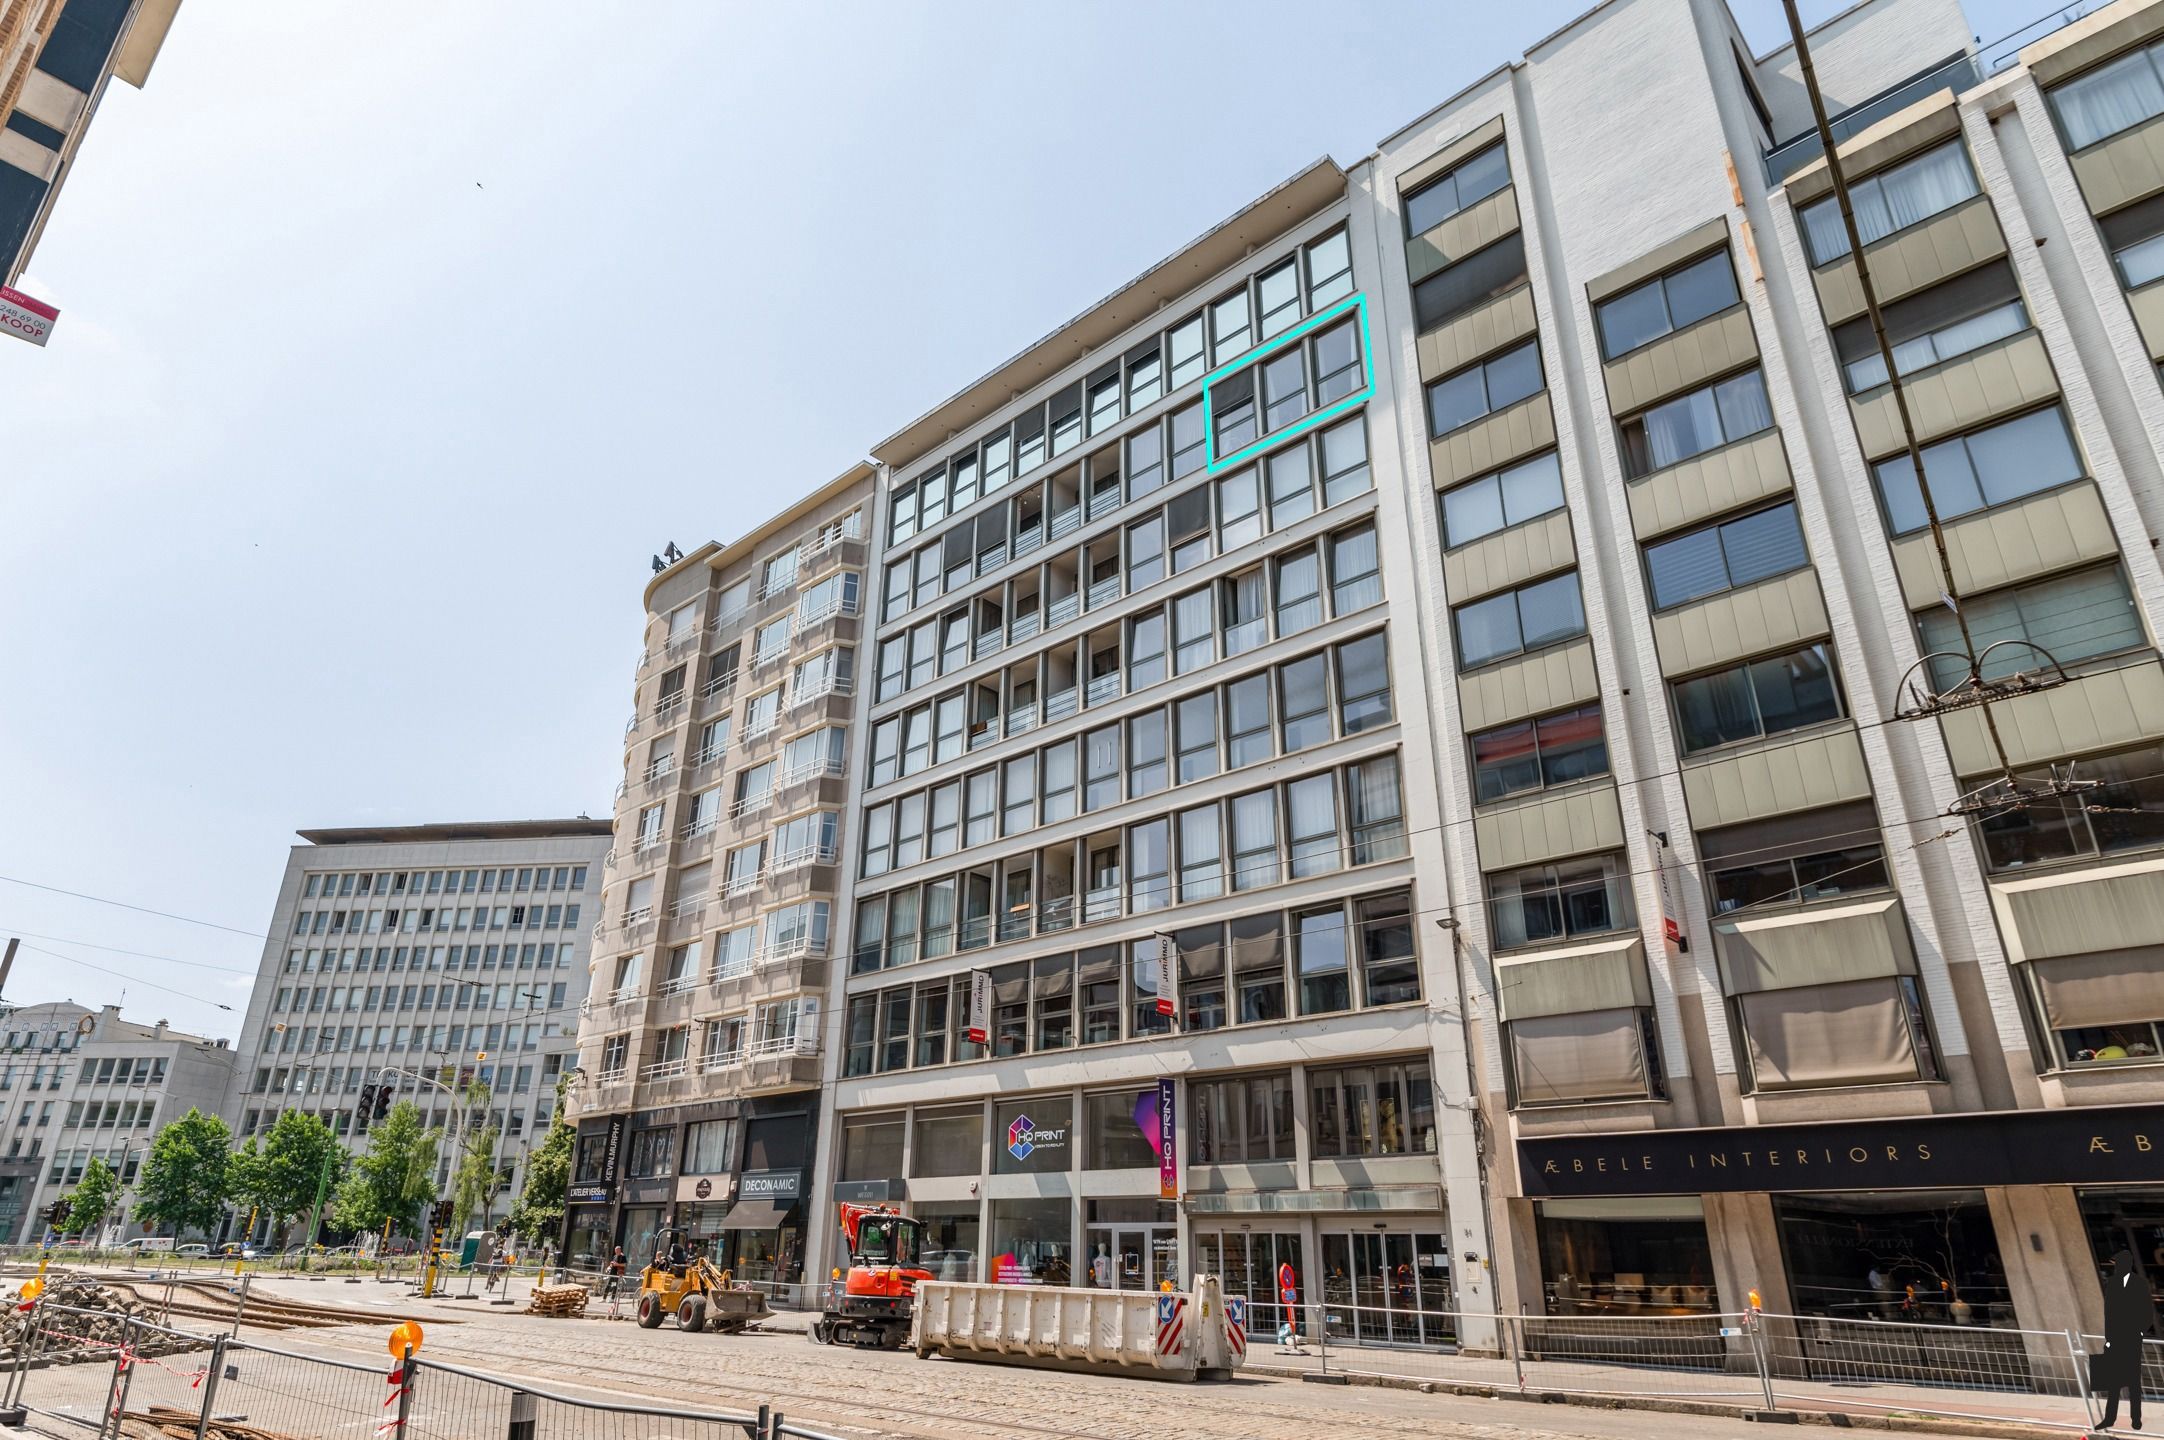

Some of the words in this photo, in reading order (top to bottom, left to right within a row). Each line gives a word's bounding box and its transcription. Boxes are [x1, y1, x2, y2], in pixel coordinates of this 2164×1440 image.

[1, 313, 43, 336] KOOP
[20, 314, 32, 322] 69
[33, 319, 46, 330] 00
[1163, 1085, 1171, 1139] PRINT
[1018, 1132, 1033, 1143] HQ
[1034, 1130, 1065, 1141] PRINT
[1164, 1142, 1172, 1170] HQ
[1544, 1156, 1653, 1173] ÆBELE
[1689, 1144, 1931, 1169] INTERIORS
[745, 1178, 795, 1191] DECONAMIC
